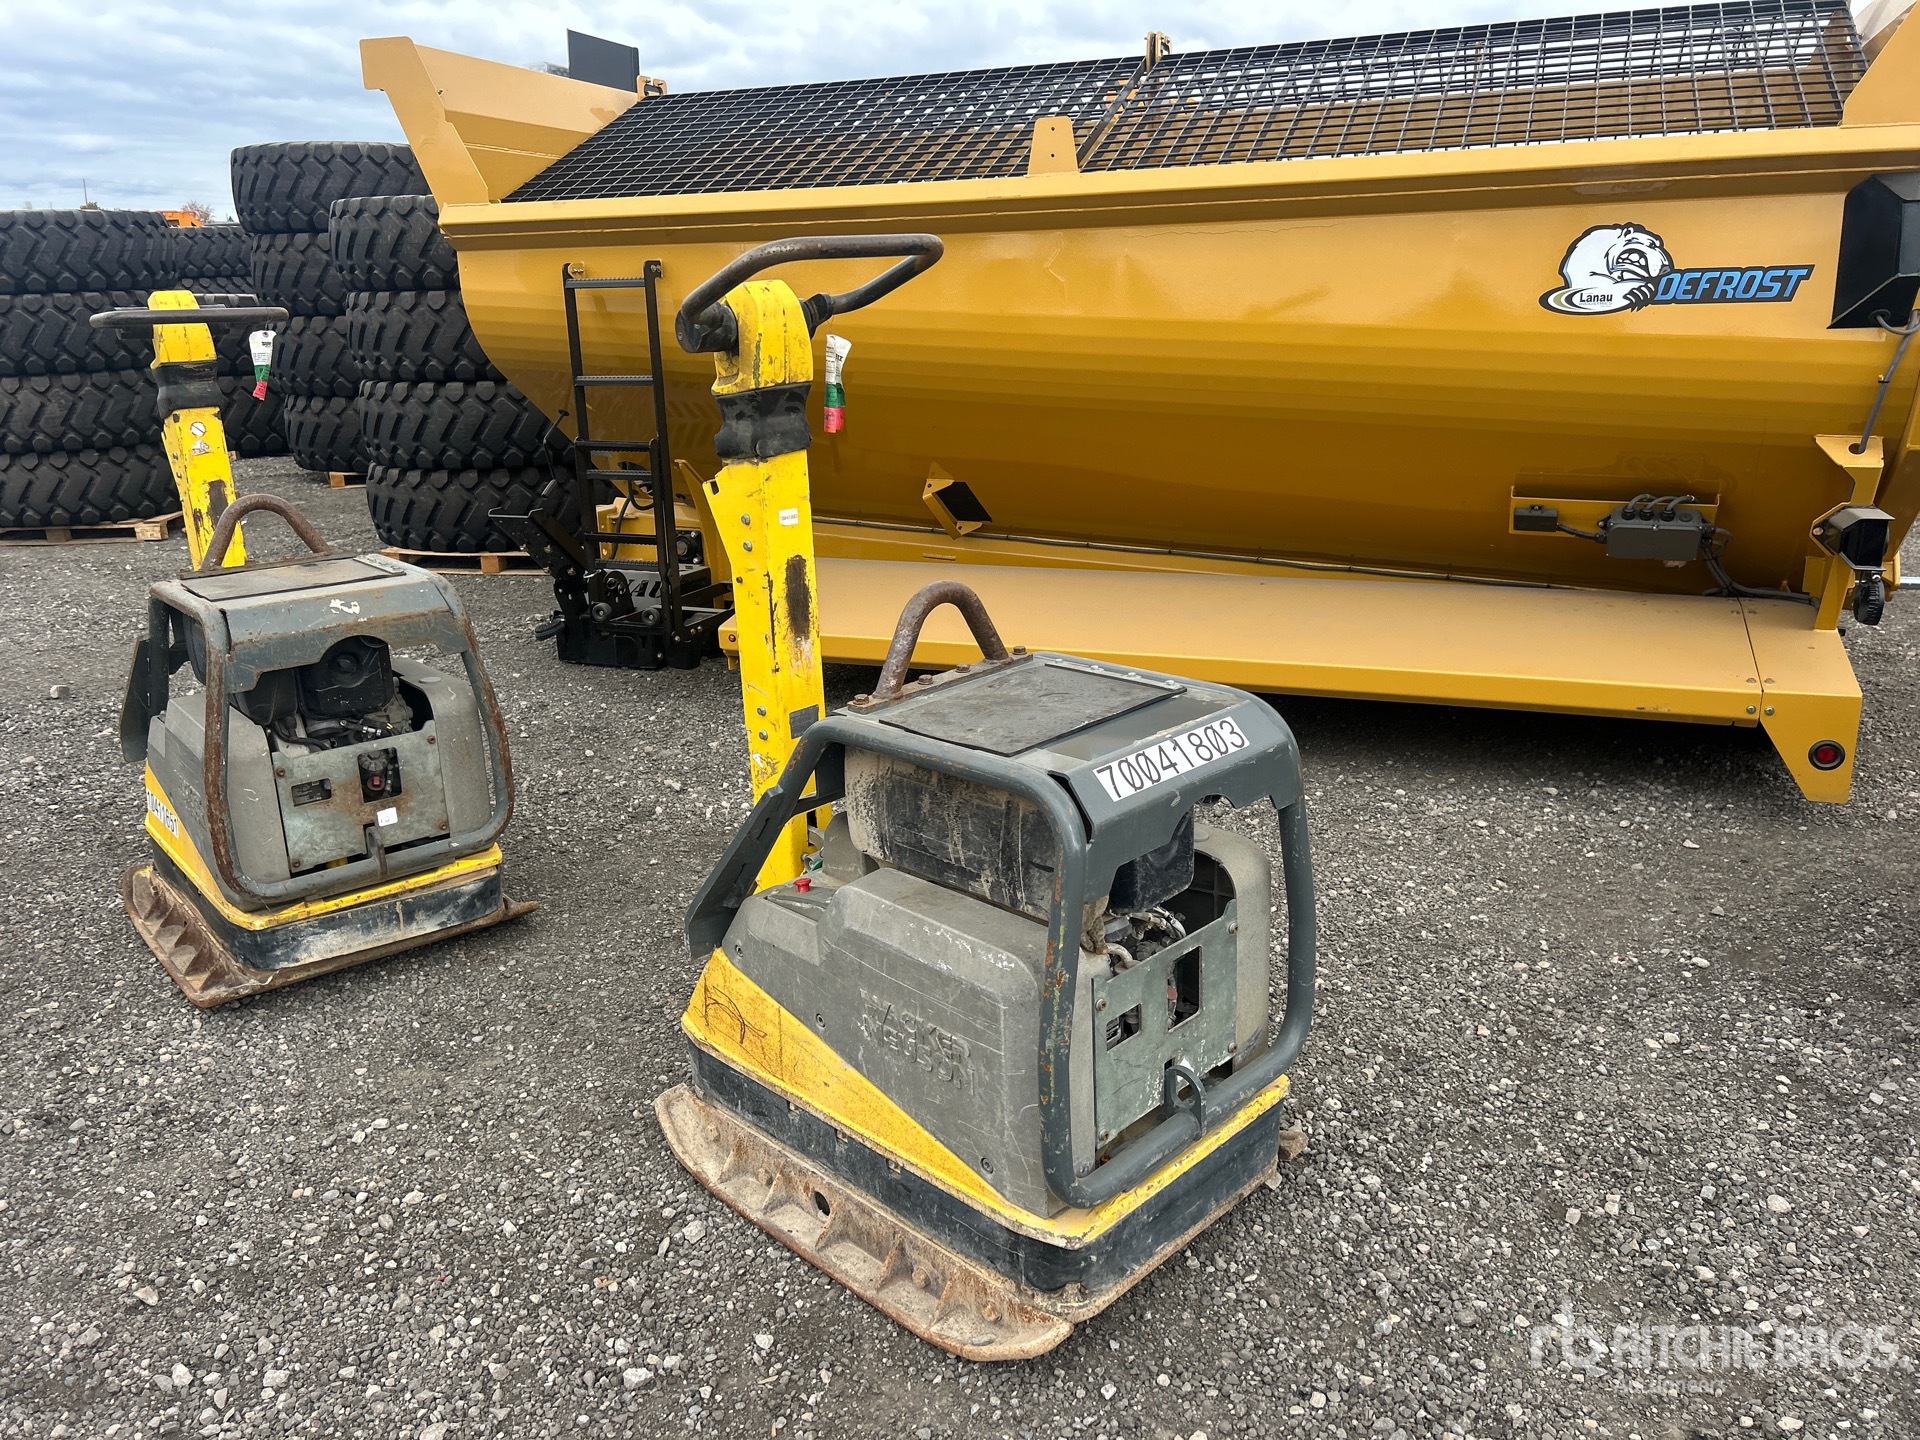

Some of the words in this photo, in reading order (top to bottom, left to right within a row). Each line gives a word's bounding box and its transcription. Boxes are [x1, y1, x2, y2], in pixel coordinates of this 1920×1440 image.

[1580, 292, 1613, 303] Lanau
[1654, 269, 1809, 300] DEFROST
[1097, 720, 1245, 798] 70041803
